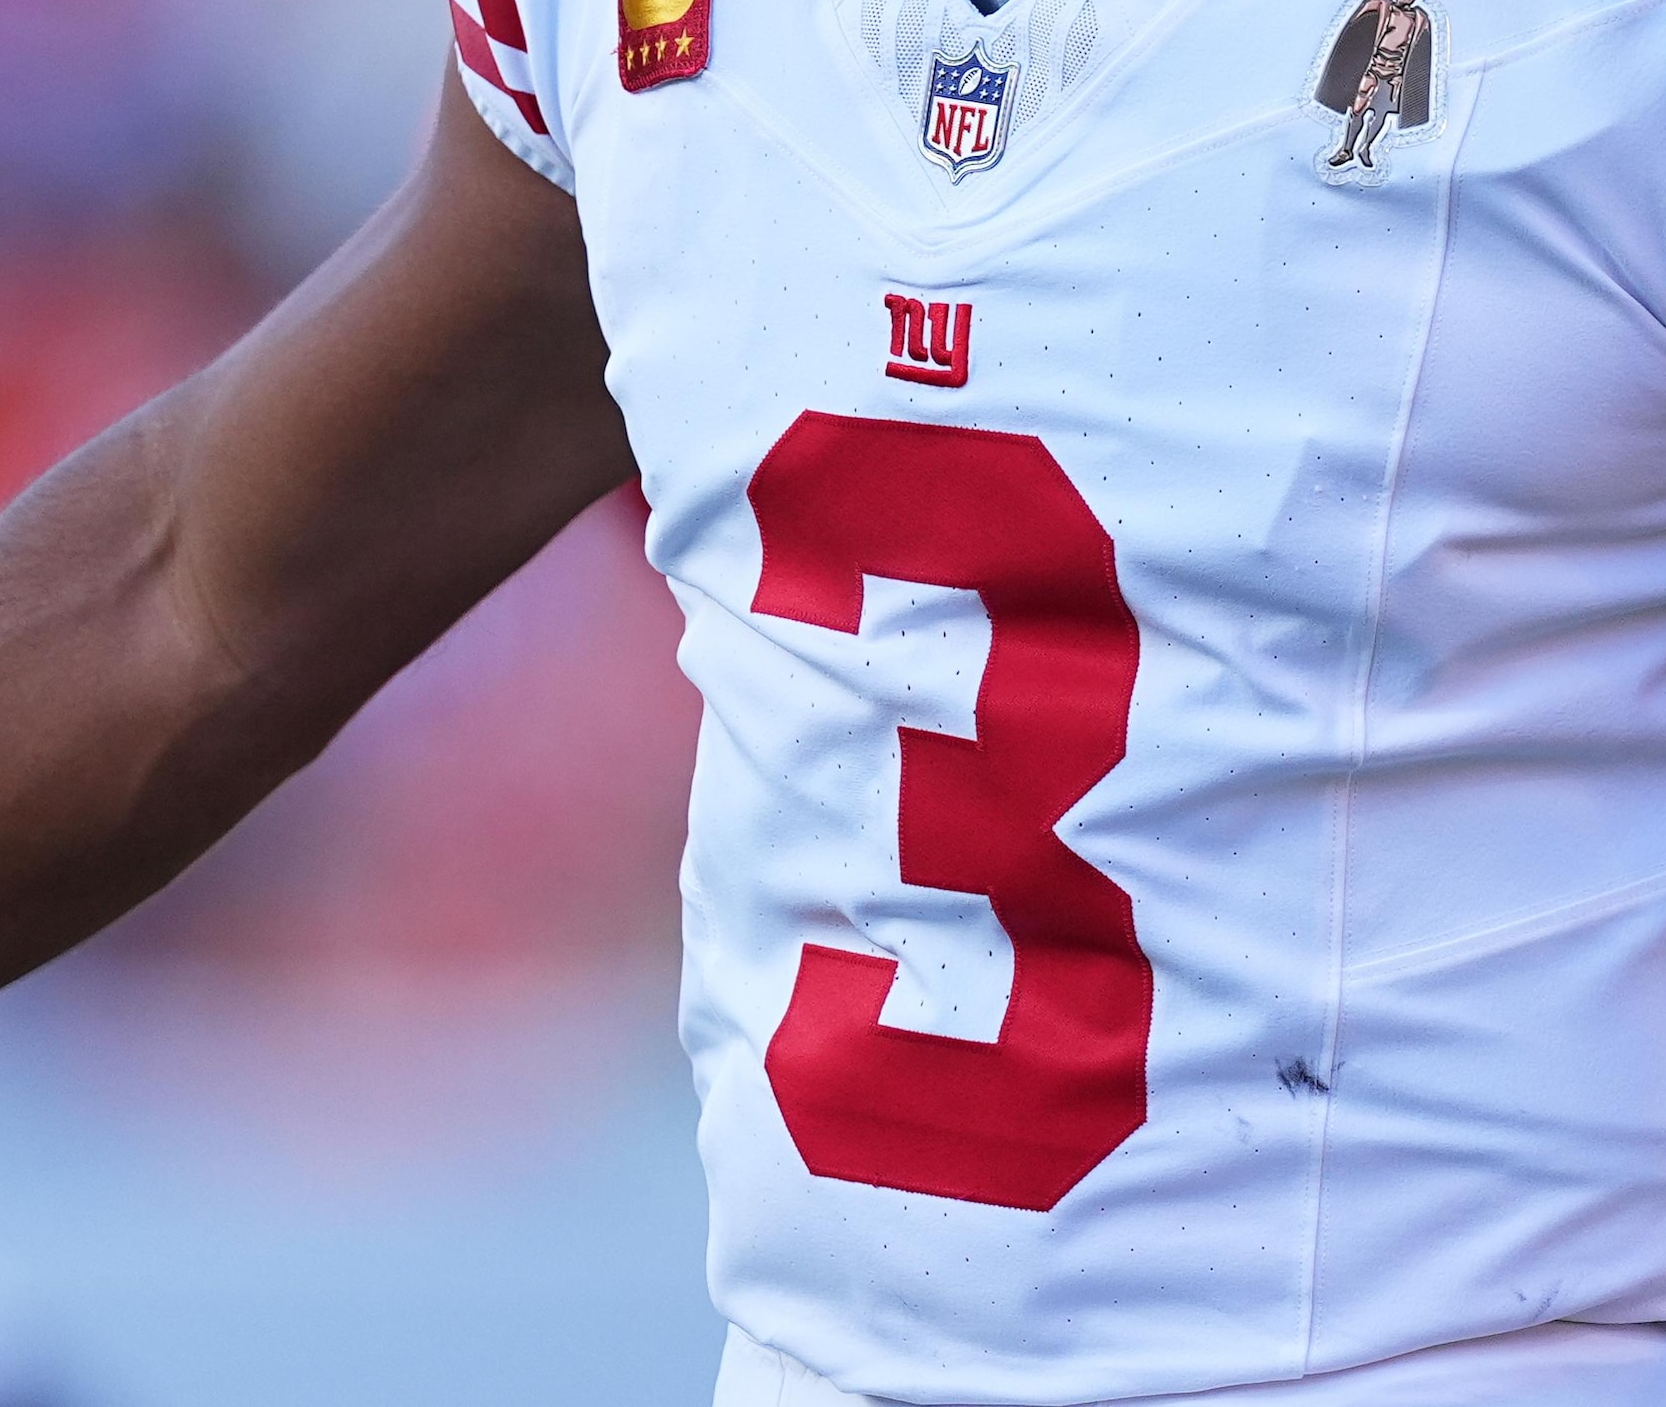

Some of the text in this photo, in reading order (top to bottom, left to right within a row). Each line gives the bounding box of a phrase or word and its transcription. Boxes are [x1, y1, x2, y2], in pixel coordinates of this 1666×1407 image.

[932, 101, 989, 157] NFL
[884, 293, 973, 388] ny
[747, 409, 1154, 1213] 3
